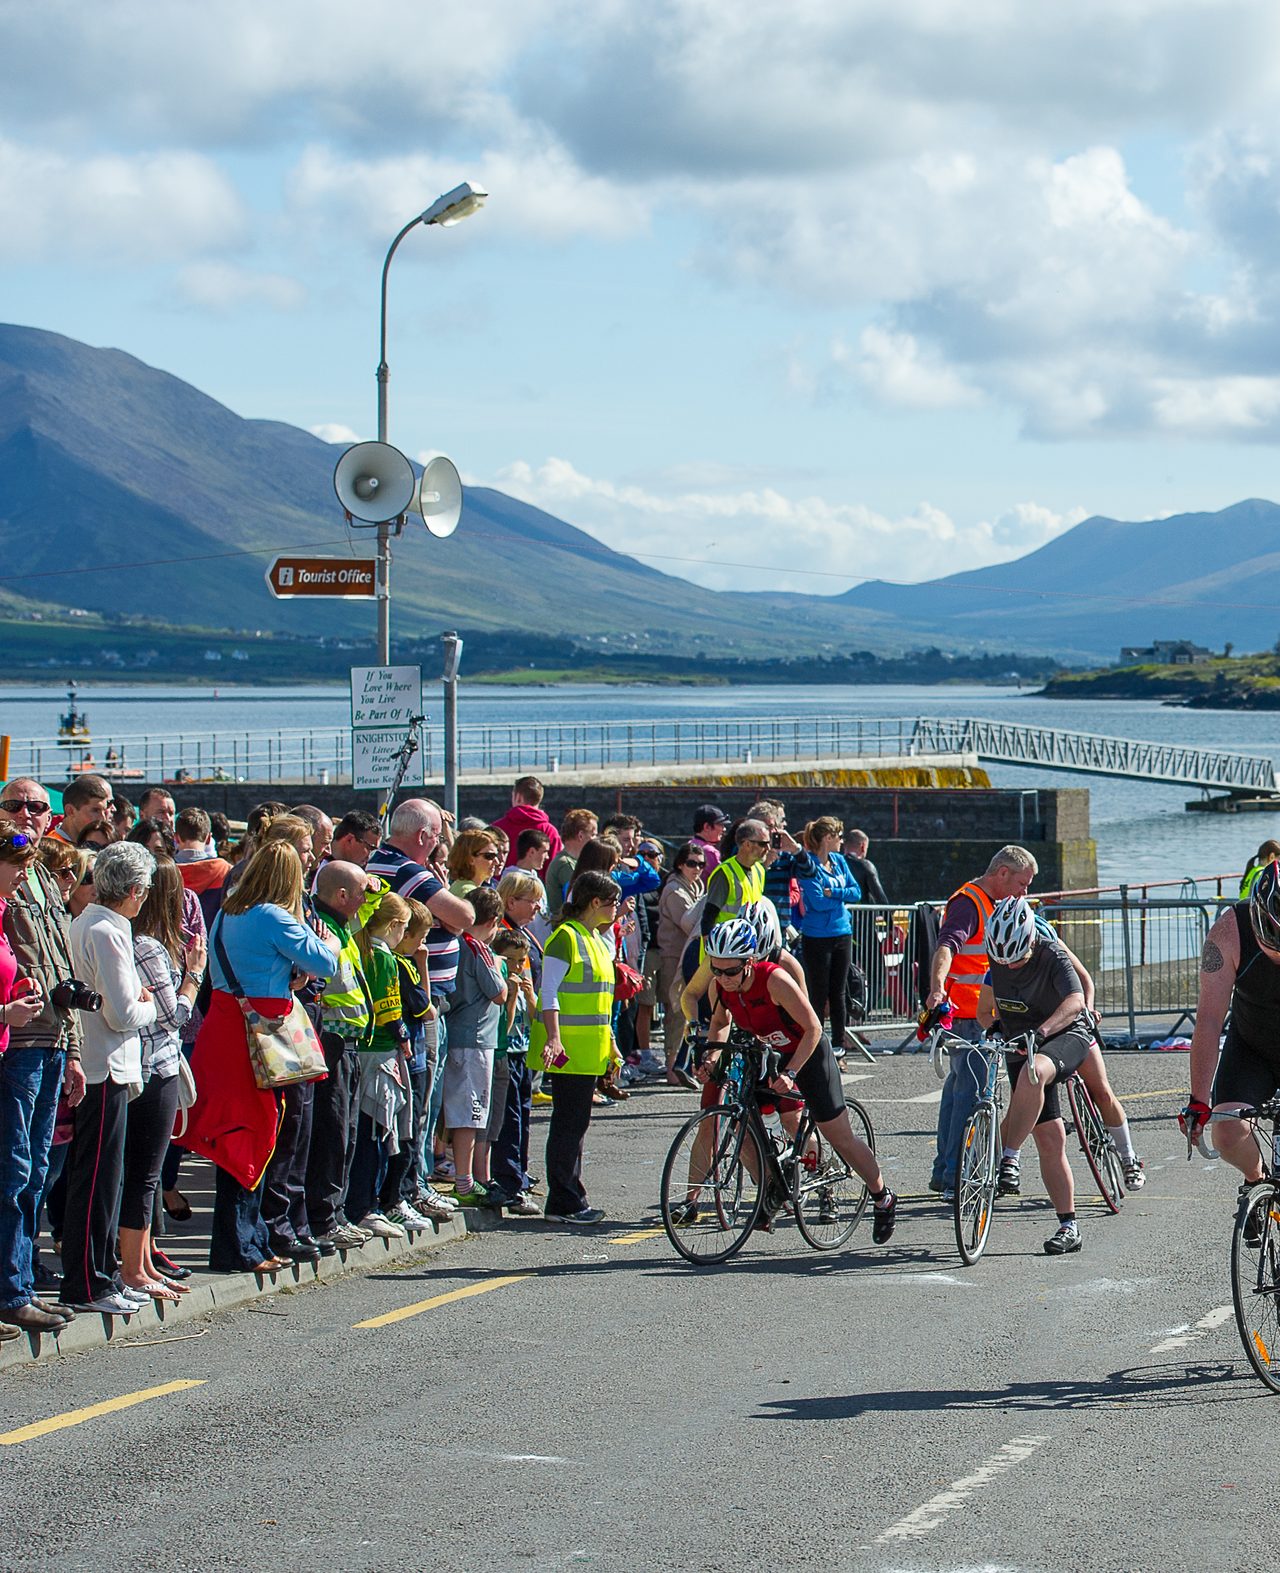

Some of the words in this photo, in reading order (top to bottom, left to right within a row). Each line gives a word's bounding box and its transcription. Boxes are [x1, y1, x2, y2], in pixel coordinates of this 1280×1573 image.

[298, 568, 336, 583] Tourist
[338, 569, 372, 583] Office
[367, 671, 374, 682] If
[379, 671, 392, 680] You
[364, 684, 382, 692] Love
[386, 682, 412, 691] Where
[361, 695, 374, 704] You
[378, 694, 396, 703] Live
[355, 710, 365, 720] Be
[369, 710, 387, 719] Part
[391, 708, 402, 720] Of
[406, 708, 412, 718] It
[373, 746, 394, 754] Litter
[357, 776, 380, 784] Please
